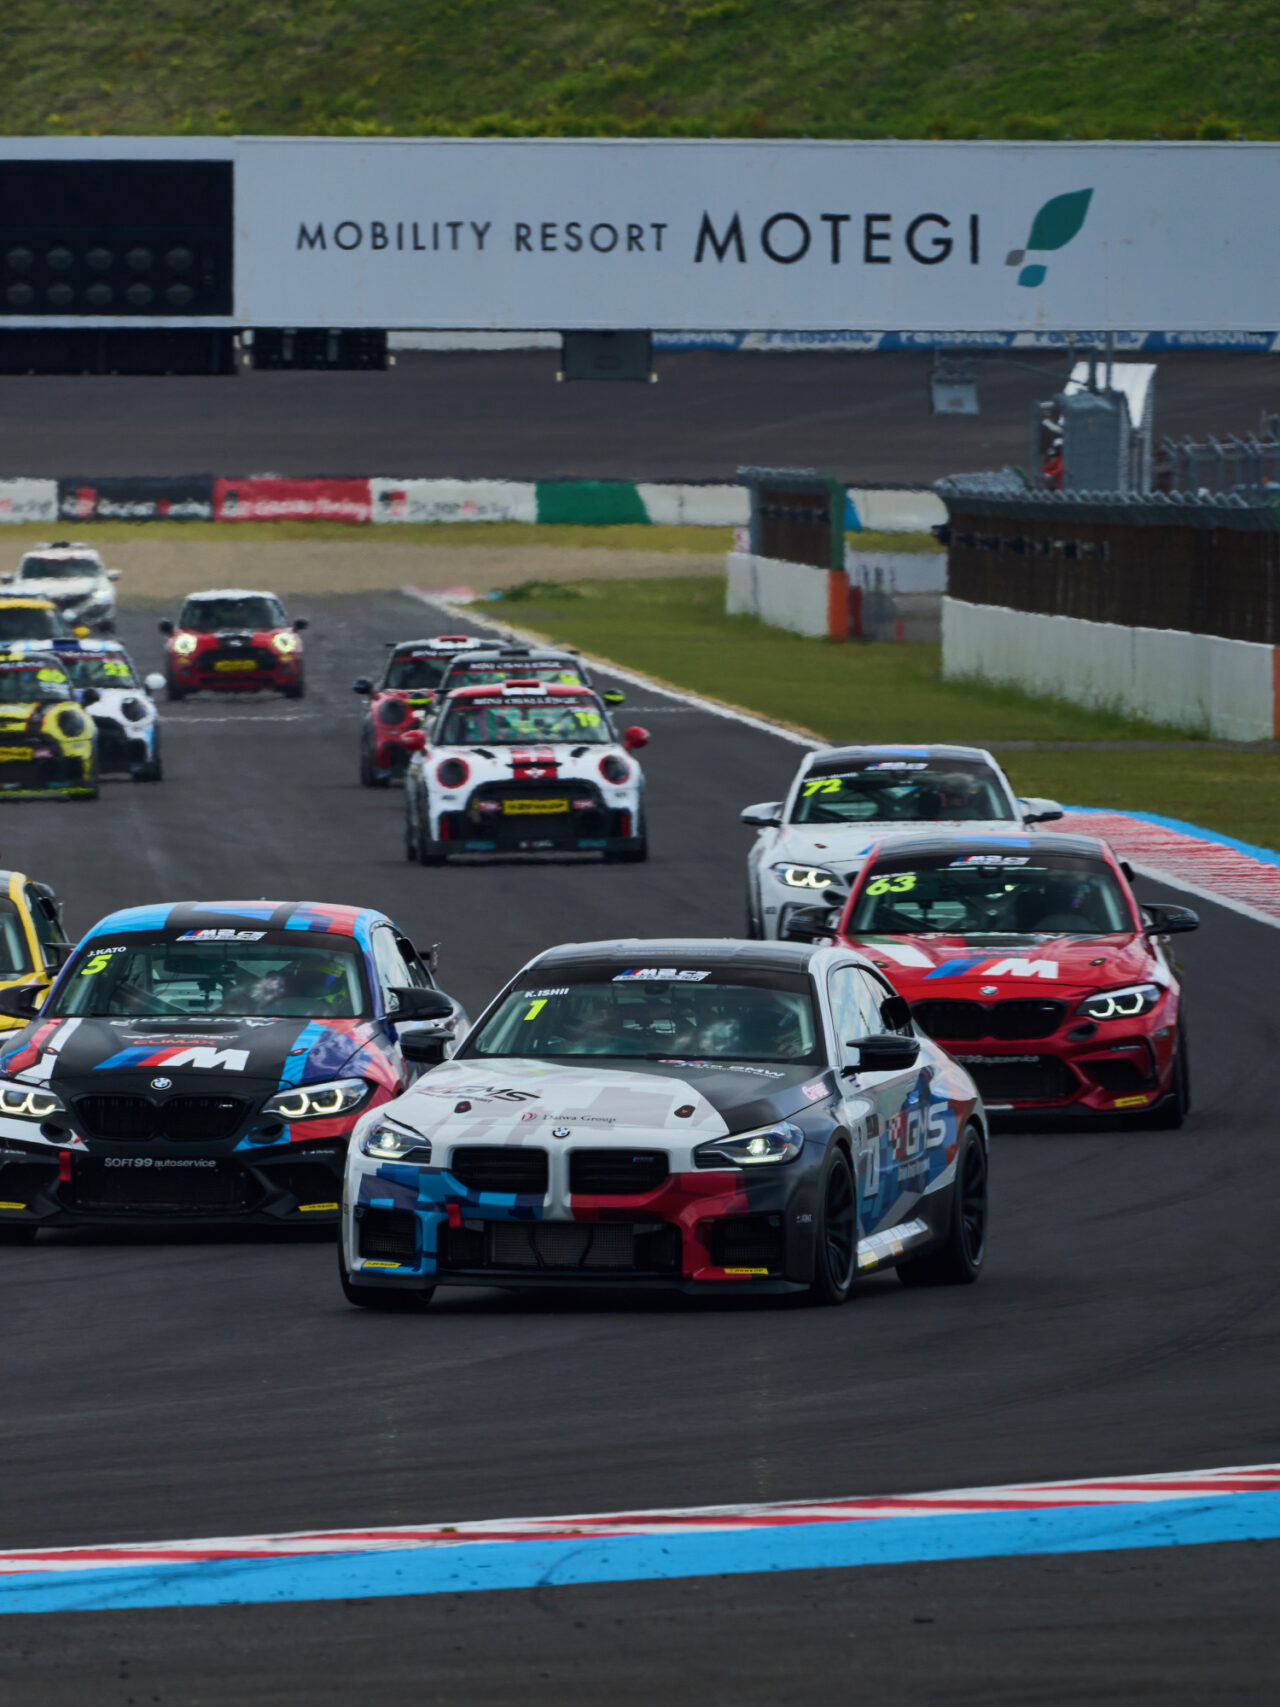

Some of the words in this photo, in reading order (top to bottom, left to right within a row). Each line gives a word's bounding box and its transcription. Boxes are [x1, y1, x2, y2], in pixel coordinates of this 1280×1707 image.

[296, 221, 492, 252] MOBILITY
[516, 222, 669, 253] RESORT
[694, 211, 980, 264] MOTEGI
[802, 778, 842, 797] 72
[865, 875, 917, 896] 63
[80, 954, 113, 975] 5
[523, 999, 548, 1021] 1
[154, 1158, 217, 1168] autoservice
